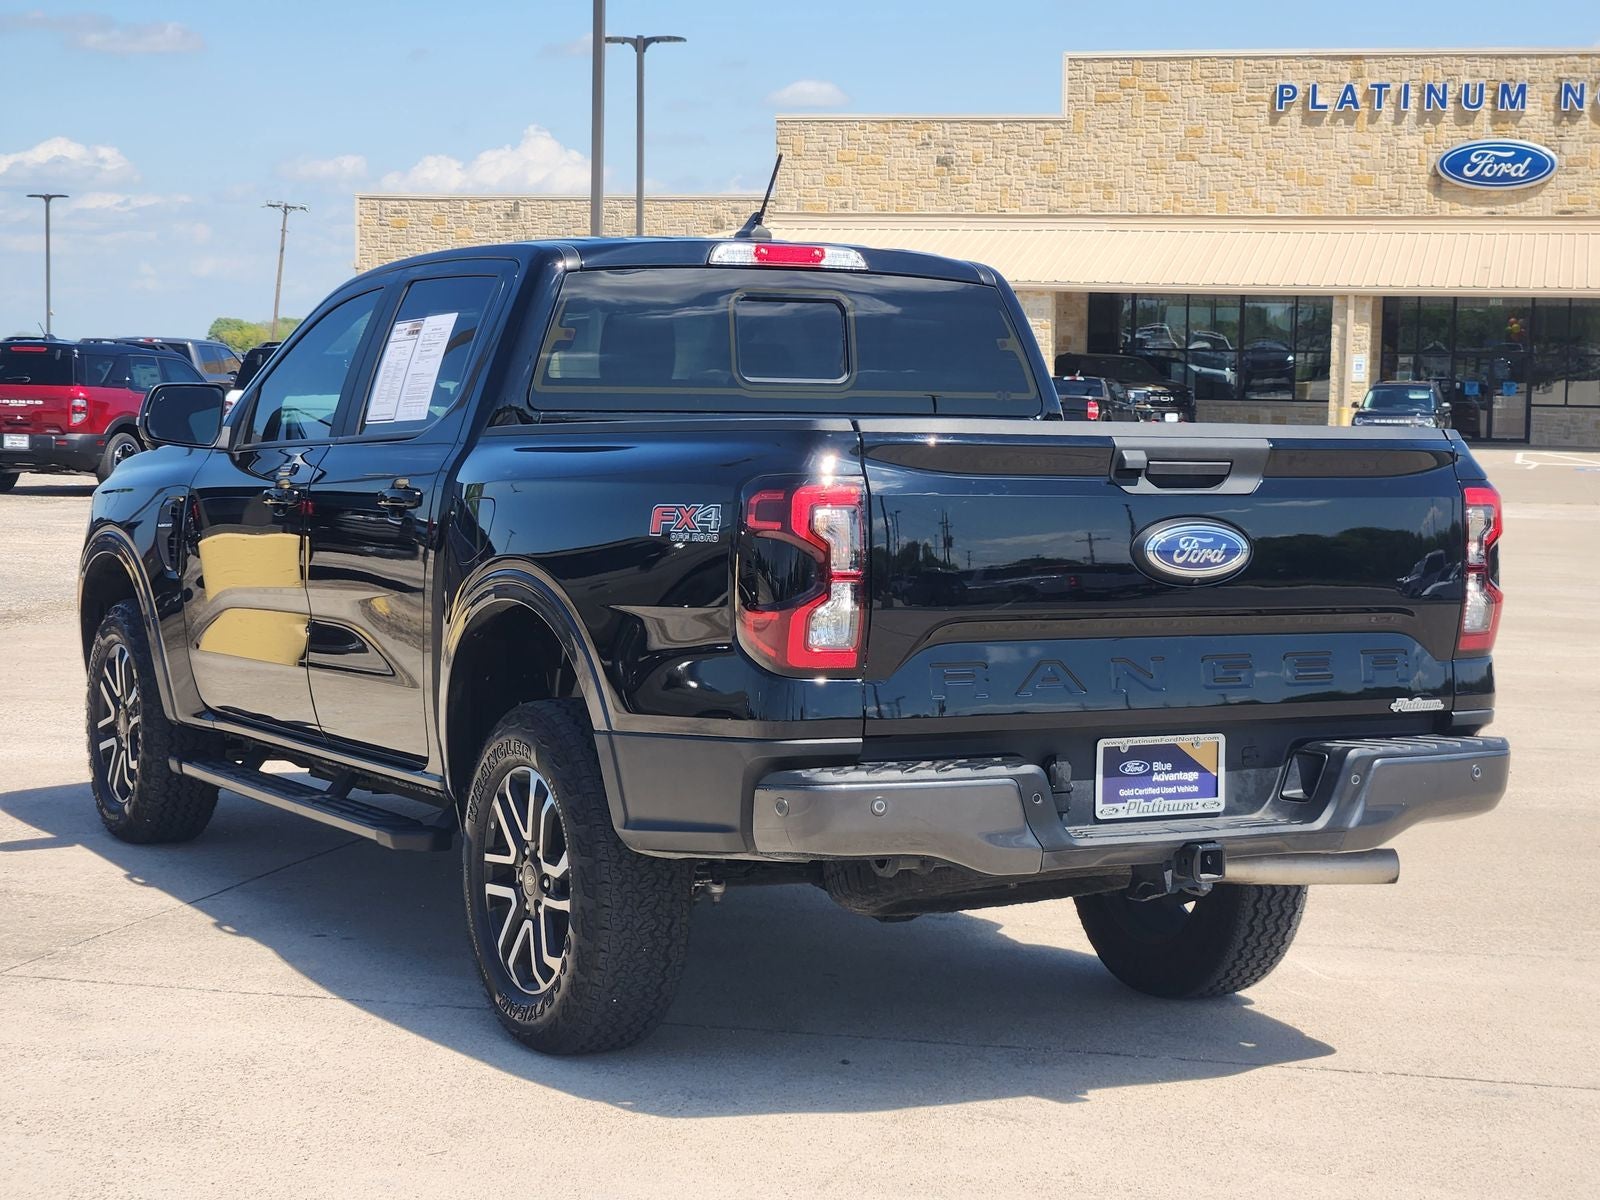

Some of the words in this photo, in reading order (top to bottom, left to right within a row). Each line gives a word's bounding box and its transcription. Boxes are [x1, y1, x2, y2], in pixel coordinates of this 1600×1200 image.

[1276, 82, 1528, 111] PLATINUM
[1561, 82, 1600, 111] N
[1462, 149, 1532, 178] Ford
[649, 503, 722, 537] FX4
[670, 532, 690, 542] OFF
[691, 533, 719, 543] ROAD
[1172, 536, 1227, 564] Ford
[930, 649, 1411, 699] RANGER
[1124, 762, 1144, 773] Ford
[1152, 761, 1172, 771] Blue
[1152, 771, 1199, 782] Advantage
[467, 739, 531, 823] WRANGLER
[1119, 788, 1133, 796] Gold
[1134, 786, 1160, 796] Certified
[1160, 786, 1177, 794] Used
[1176, 784, 1199, 794] Vehicle
[1126, 800, 1196, 814] Platinum
